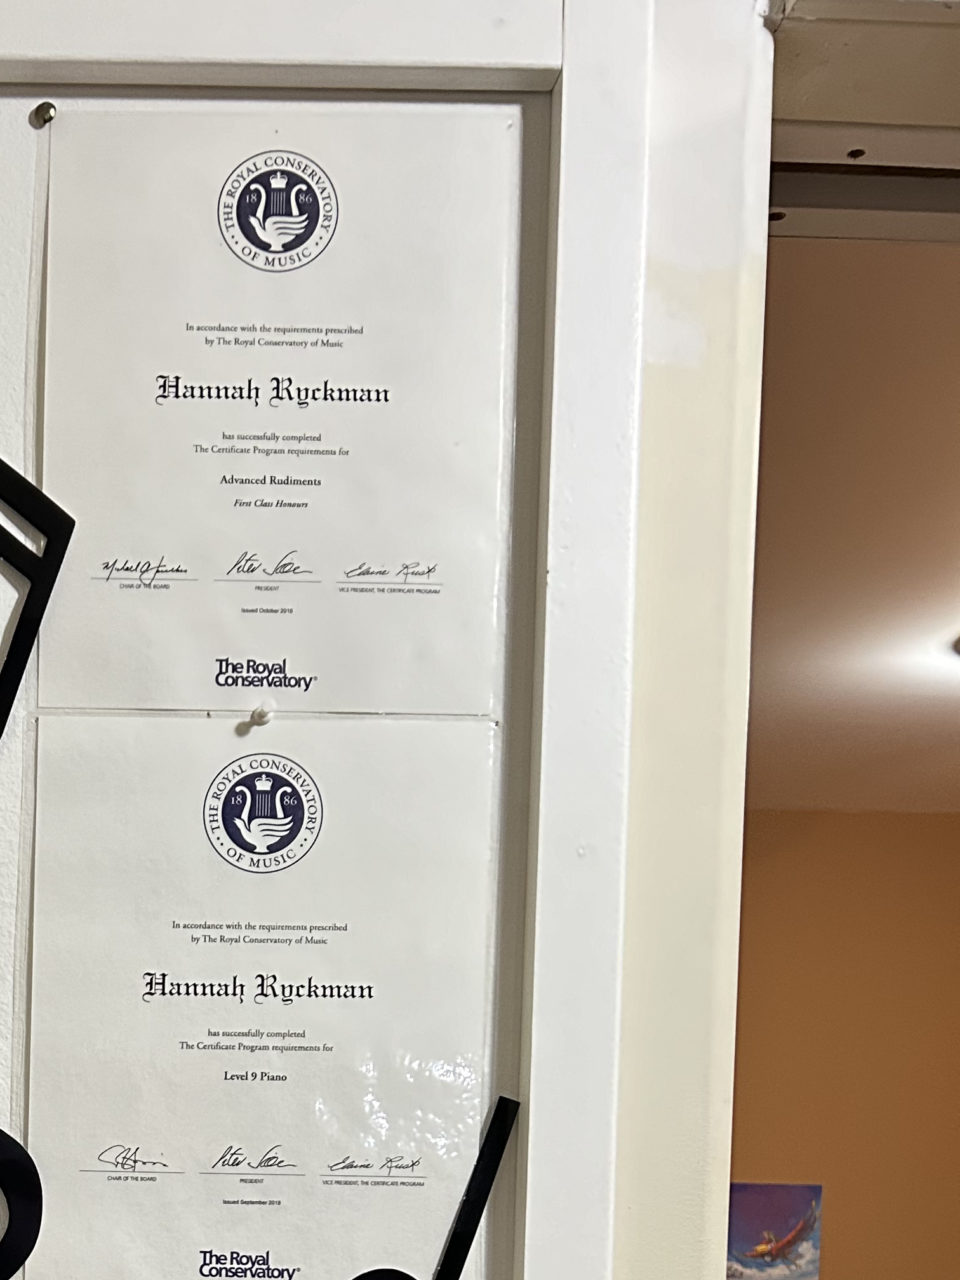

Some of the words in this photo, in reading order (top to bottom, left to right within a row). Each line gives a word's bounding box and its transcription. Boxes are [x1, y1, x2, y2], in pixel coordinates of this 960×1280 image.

[185, 322, 195, 332] In
[195, 322, 238, 333] accordance
[239, 323, 258, 333] with
[259, 323, 272, 334] the
[273, 326, 324, 336] requirements
[324, 325, 364, 337] prescribed
[204, 335, 215, 348] by
[216, 336, 232, 346] The
[233, 336, 256, 349] Royal
[257, 337, 309, 350] Conservatory
[310, 338, 319, 348] of
[320, 338, 343, 349] Music
[155, 374, 260, 408] Hannah
[269, 376, 390, 409] Ryckman
[220, 473, 267, 486] Advanced
[269, 475, 322, 487] Rudiments
[233, 498, 252, 508] First
[253, 498, 274, 508] Class
[274, 499, 309, 509] Honours
[215, 657, 244, 674] The
[246, 658, 286, 678] Royal
[215, 673, 313, 692] Conservatory
[211, 763, 248, 801] ROYAL
[230, 794, 243, 806] 18
[249, 758, 318, 835] CONSERVATORY
[283, 794, 298, 806] 86
[208, 803, 221, 834] THE
[226, 847, 246, 863] OF
[248, 848, 297, 869] MUSIC
[142, 971, 246, 1005] Hannah
[254, 973, 374, 1006] Ryckman
[223, 1070, 249, 1081] Level
[250, 1071, 258, 1082] 9
[260, 1071, 288, 1082] Piano
[199, 1249, 227, 1266] The
[230, 1250, 270, 1269] Royal
